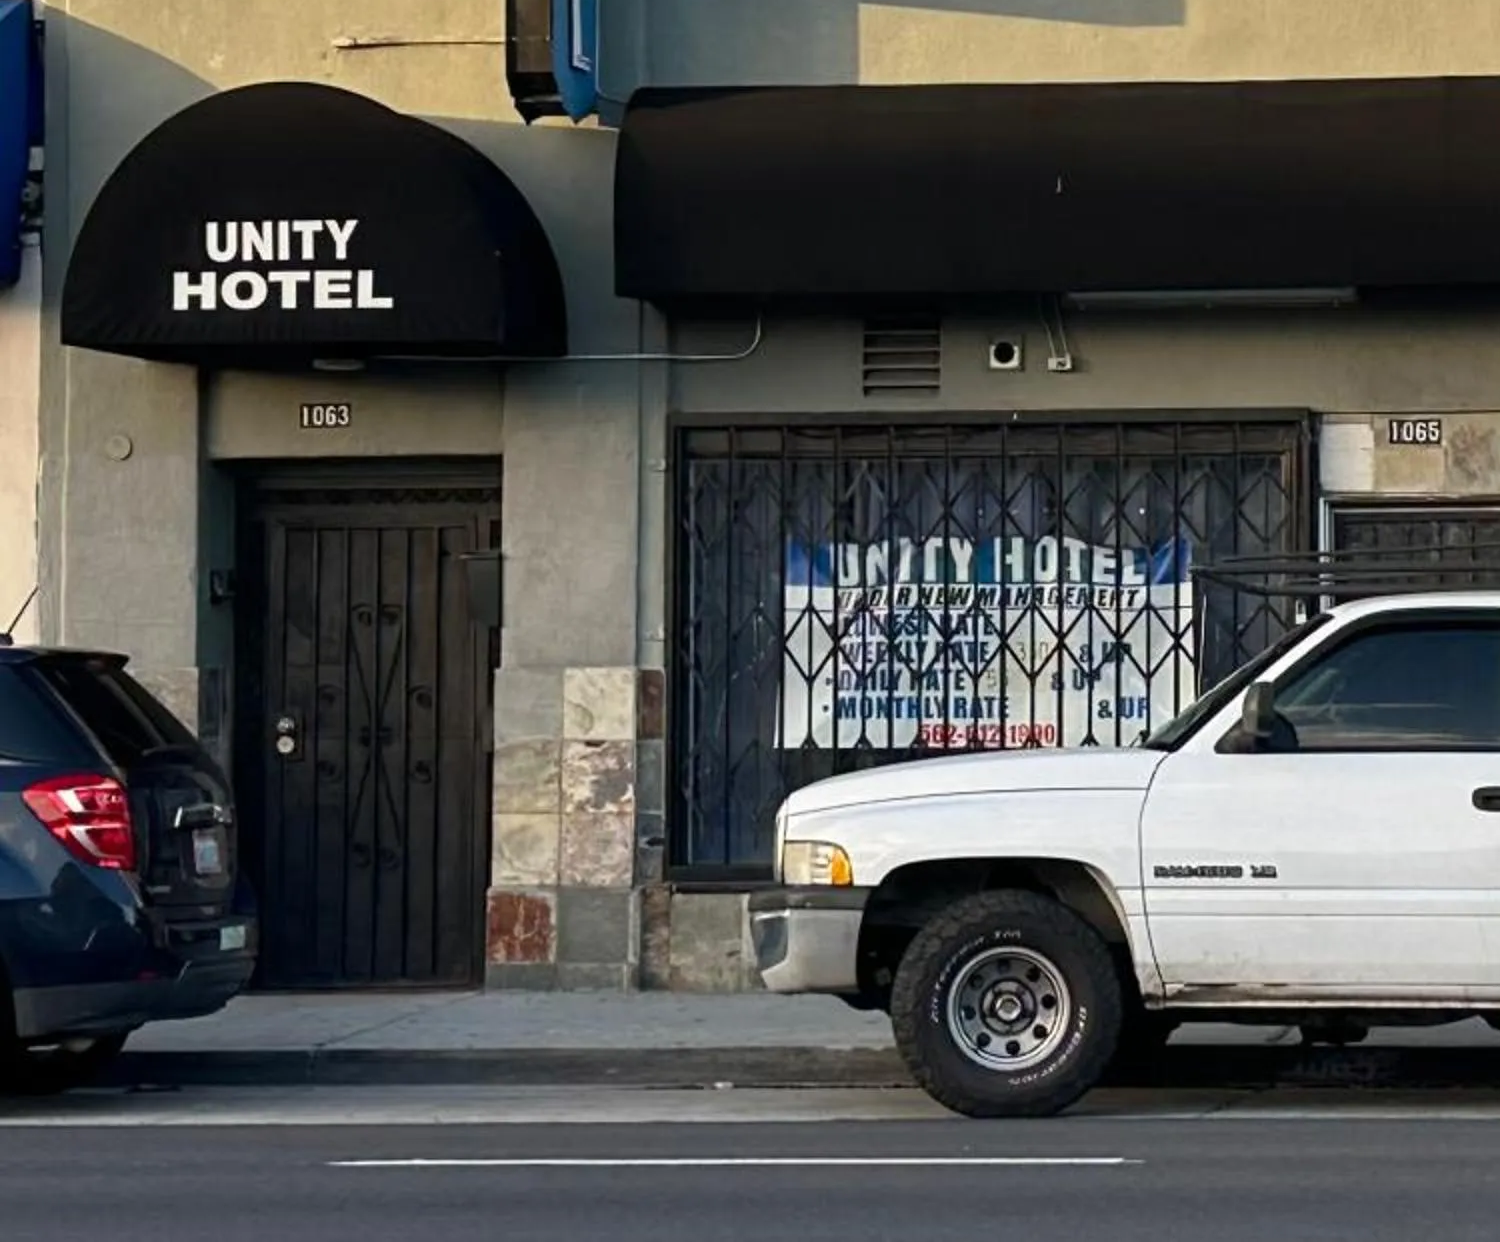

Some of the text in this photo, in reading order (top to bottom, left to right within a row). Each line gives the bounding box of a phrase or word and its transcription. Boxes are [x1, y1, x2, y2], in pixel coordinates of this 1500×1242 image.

[206, 219, 358, 262] UNITY
[173, 269, 394, 310] HOTEL
[303, 405, 349, 427] 1063
[1392, 421, 1439, 442] 1065
[837, 535, 1145, 587] UNITY HOTEL
[1097, 699, 1113, 719] &
